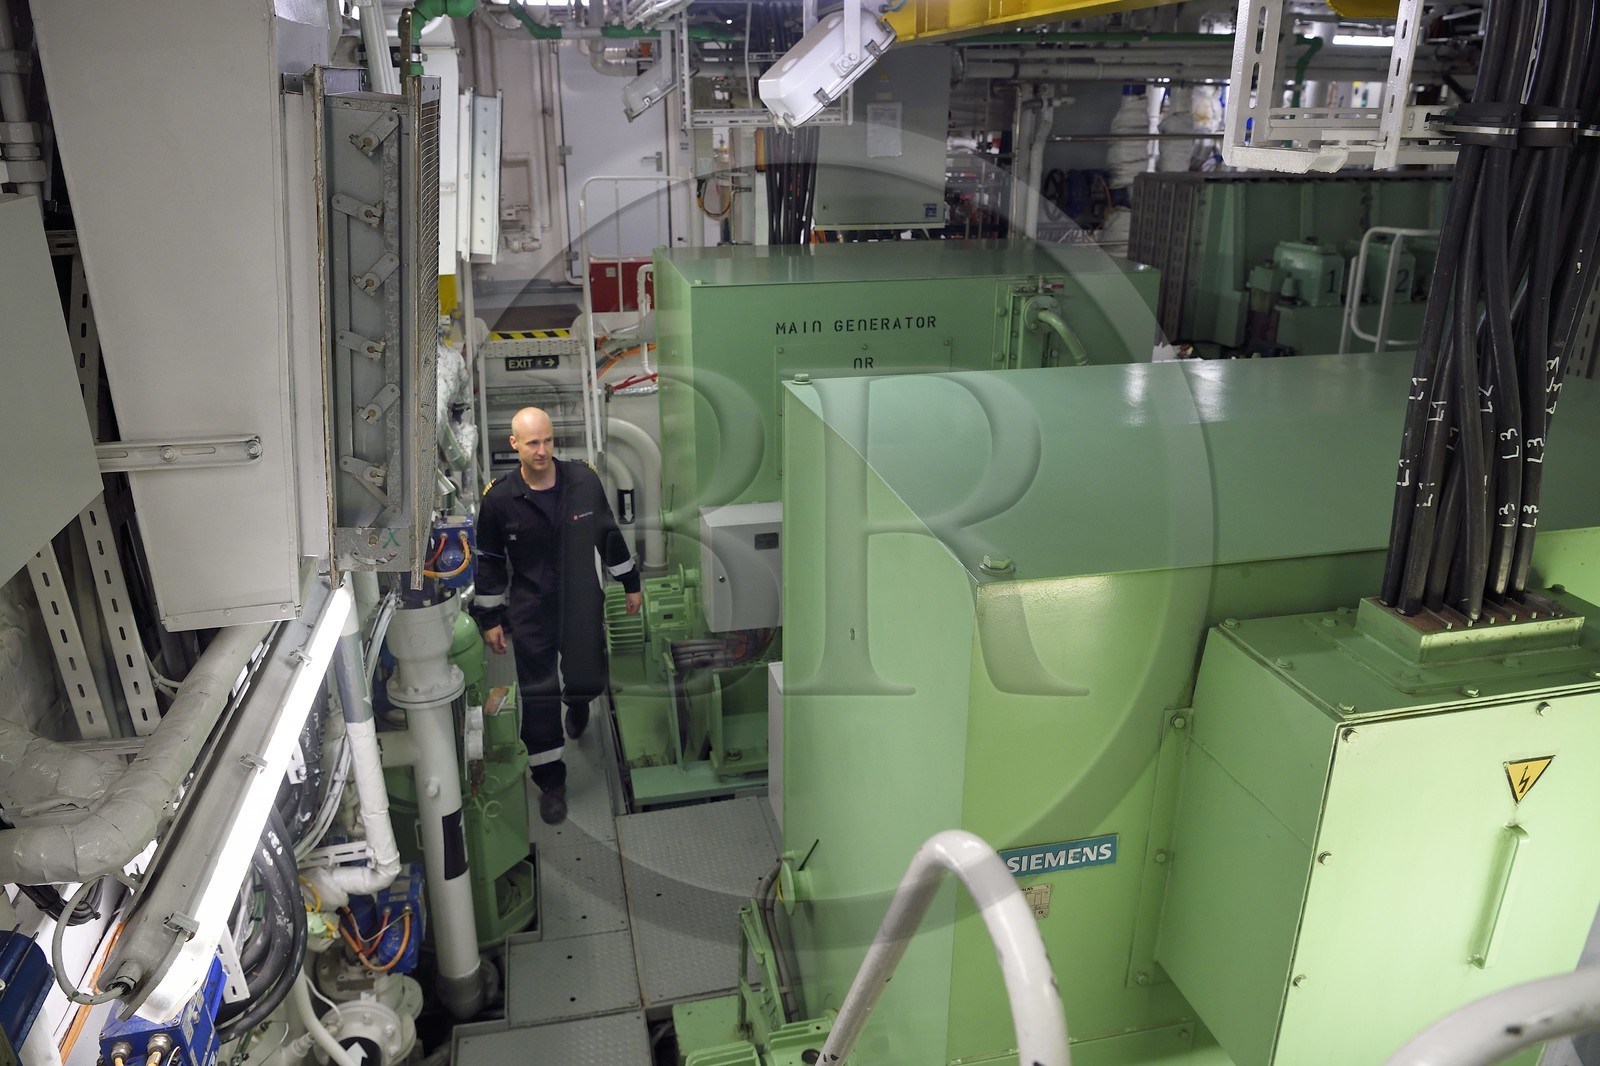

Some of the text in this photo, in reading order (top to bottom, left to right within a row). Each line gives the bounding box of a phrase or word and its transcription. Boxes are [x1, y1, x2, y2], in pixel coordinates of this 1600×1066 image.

[1326, 269, 1336, 294] 1
[1394, 268, 1410, 293] 2
[775, 315, 937, 335] MAIN GENERATOR
[508, 358, 533, 369] EXIT
[853, 356, 874, 370] NR
[1408, 377, 1428, 401] L1
[1428, 401, 1448, 422] L1
[1499, 428, 1519, 460] L3
[1527, 437, 1544, 463] L3
[1499, 502, 1516, 528] L3
[1522, 504, 1540, 528] L3
[1006, 843, 1112, 873] SIEMENS
